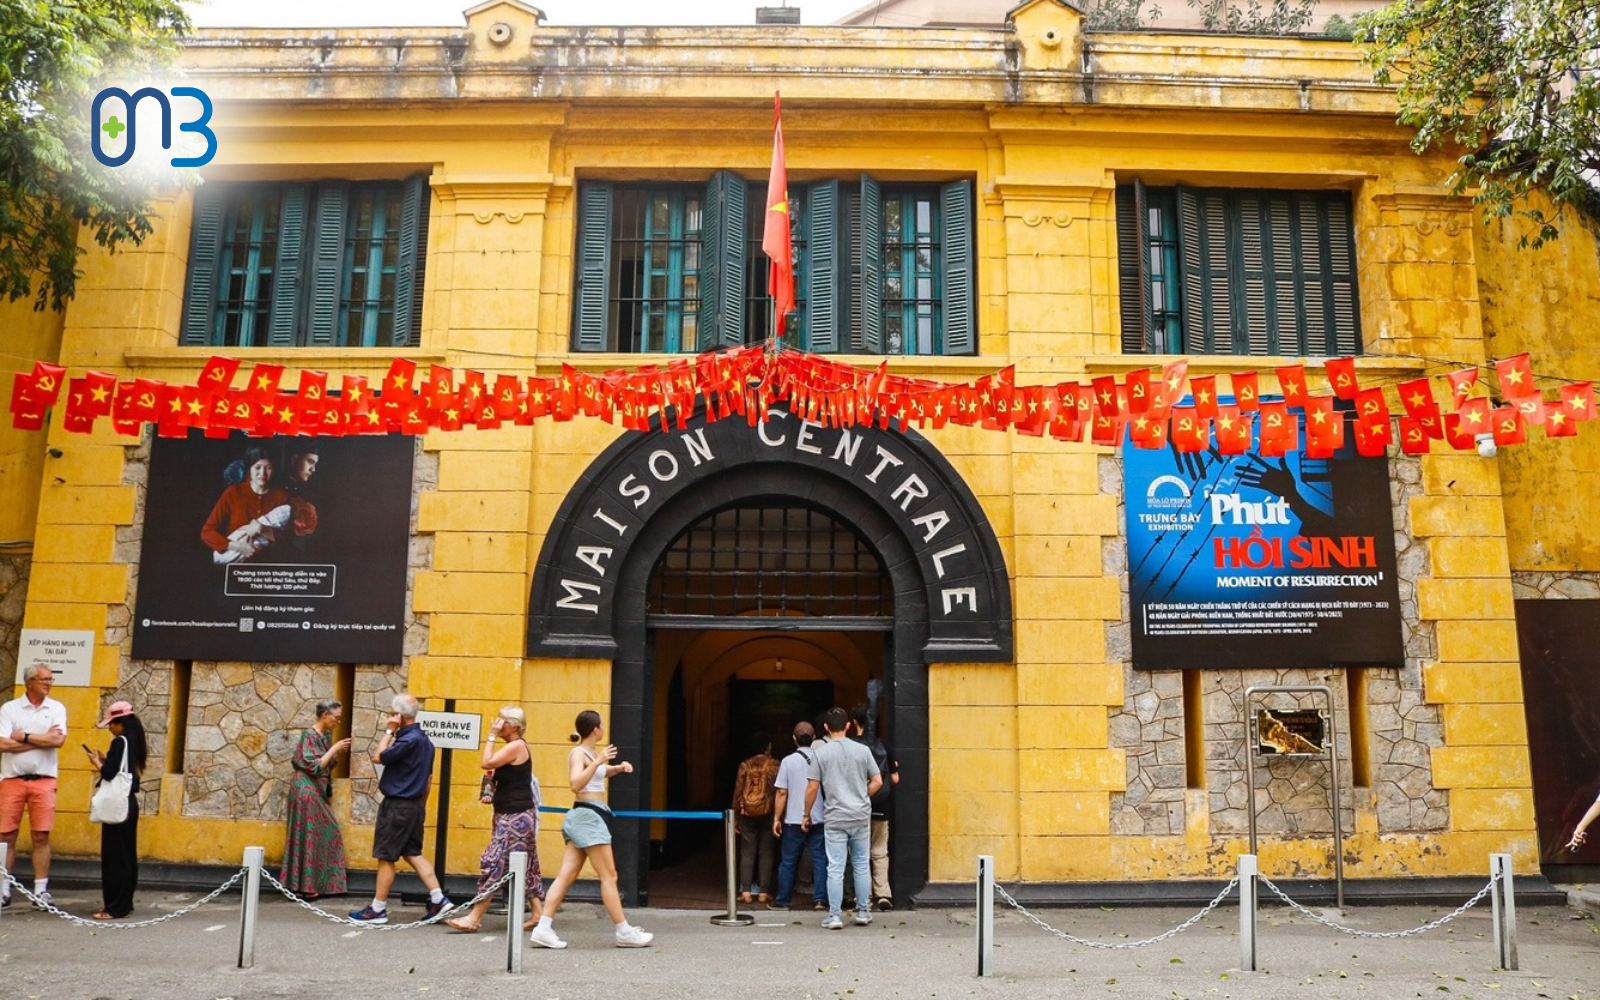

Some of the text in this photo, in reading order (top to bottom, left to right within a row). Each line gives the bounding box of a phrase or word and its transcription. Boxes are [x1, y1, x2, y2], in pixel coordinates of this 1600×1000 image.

[556, 409, 979, 616] MAISON CENTRALE
[1138, 511, 1202, 524] TRƯNG BÀY
[1148, 524, 1194, 532] EXHIBITION
[1213, 524, 1377, 569] HỒI SINH
[1217, 575, 1274, 588] MOMENT
[1274, 576, 1291, 587] OF
[422, 720, 471, 731] NƠI BÁN VÉ
[447, 731, 470, 740] Office
